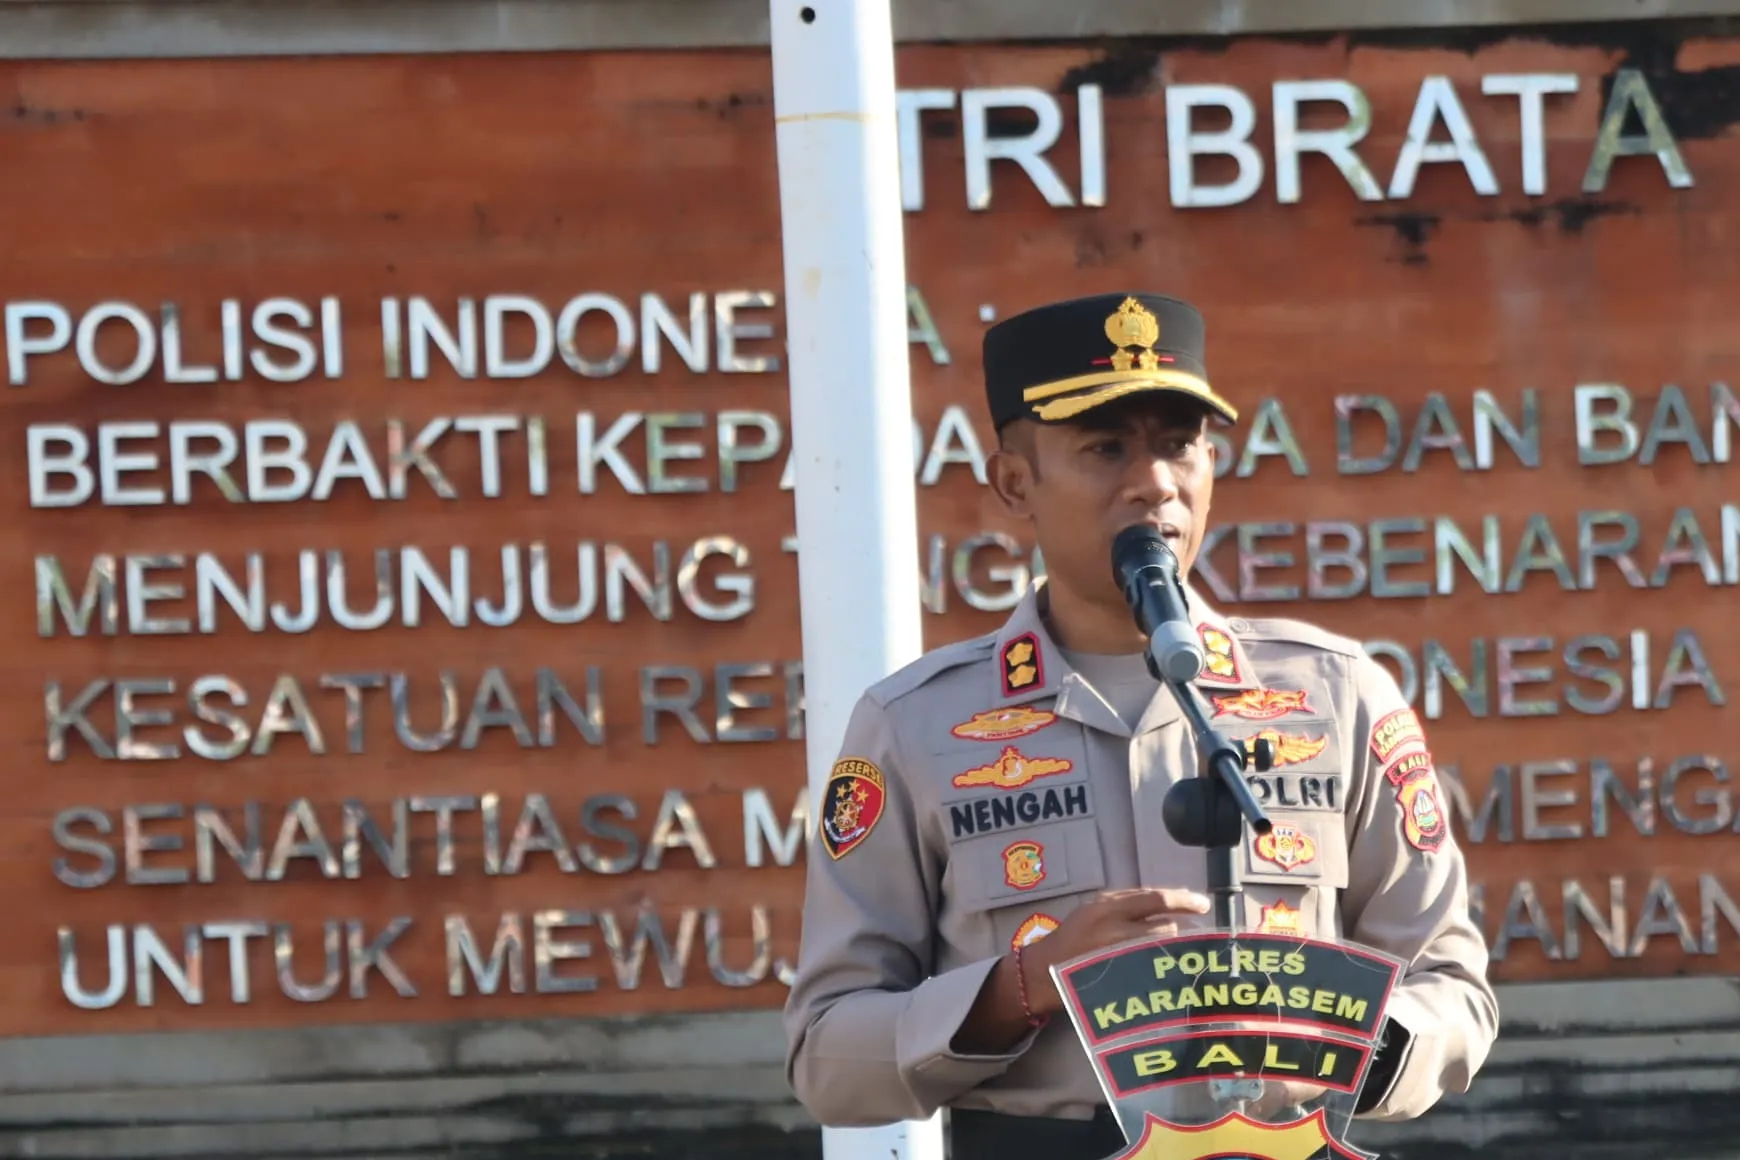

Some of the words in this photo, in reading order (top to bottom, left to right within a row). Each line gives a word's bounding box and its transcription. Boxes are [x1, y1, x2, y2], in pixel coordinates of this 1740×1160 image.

[897, 84, 1106, 212] TRI
[1166, 68, 1695, 208] BRATA
[4, 296, 343, 386] POLISI
[381, 286, 950, 384] INDONEA
[27, 416, 547, 508] BERBAKTI
[577, 406, 988, 497] KEPA
[1334, 388, 1541, 475] DAN
[35, 534, 755, 639] MENJUNJUNG
[45, 665, 603, 762] KESATUAN
[52, 788, 716, 888] SENANTIASA
[951, 785, 1087, 837] NENGAH
[1248, 776, 1336, 808] OLRI
[58, 917, 420, 1010] UNTUK
[1093, 983, 1369, 1031] KARANGASEM
[1153, 950, 1306, 980] POLRES
[1133, 1043, 1337, 1078] BALI
